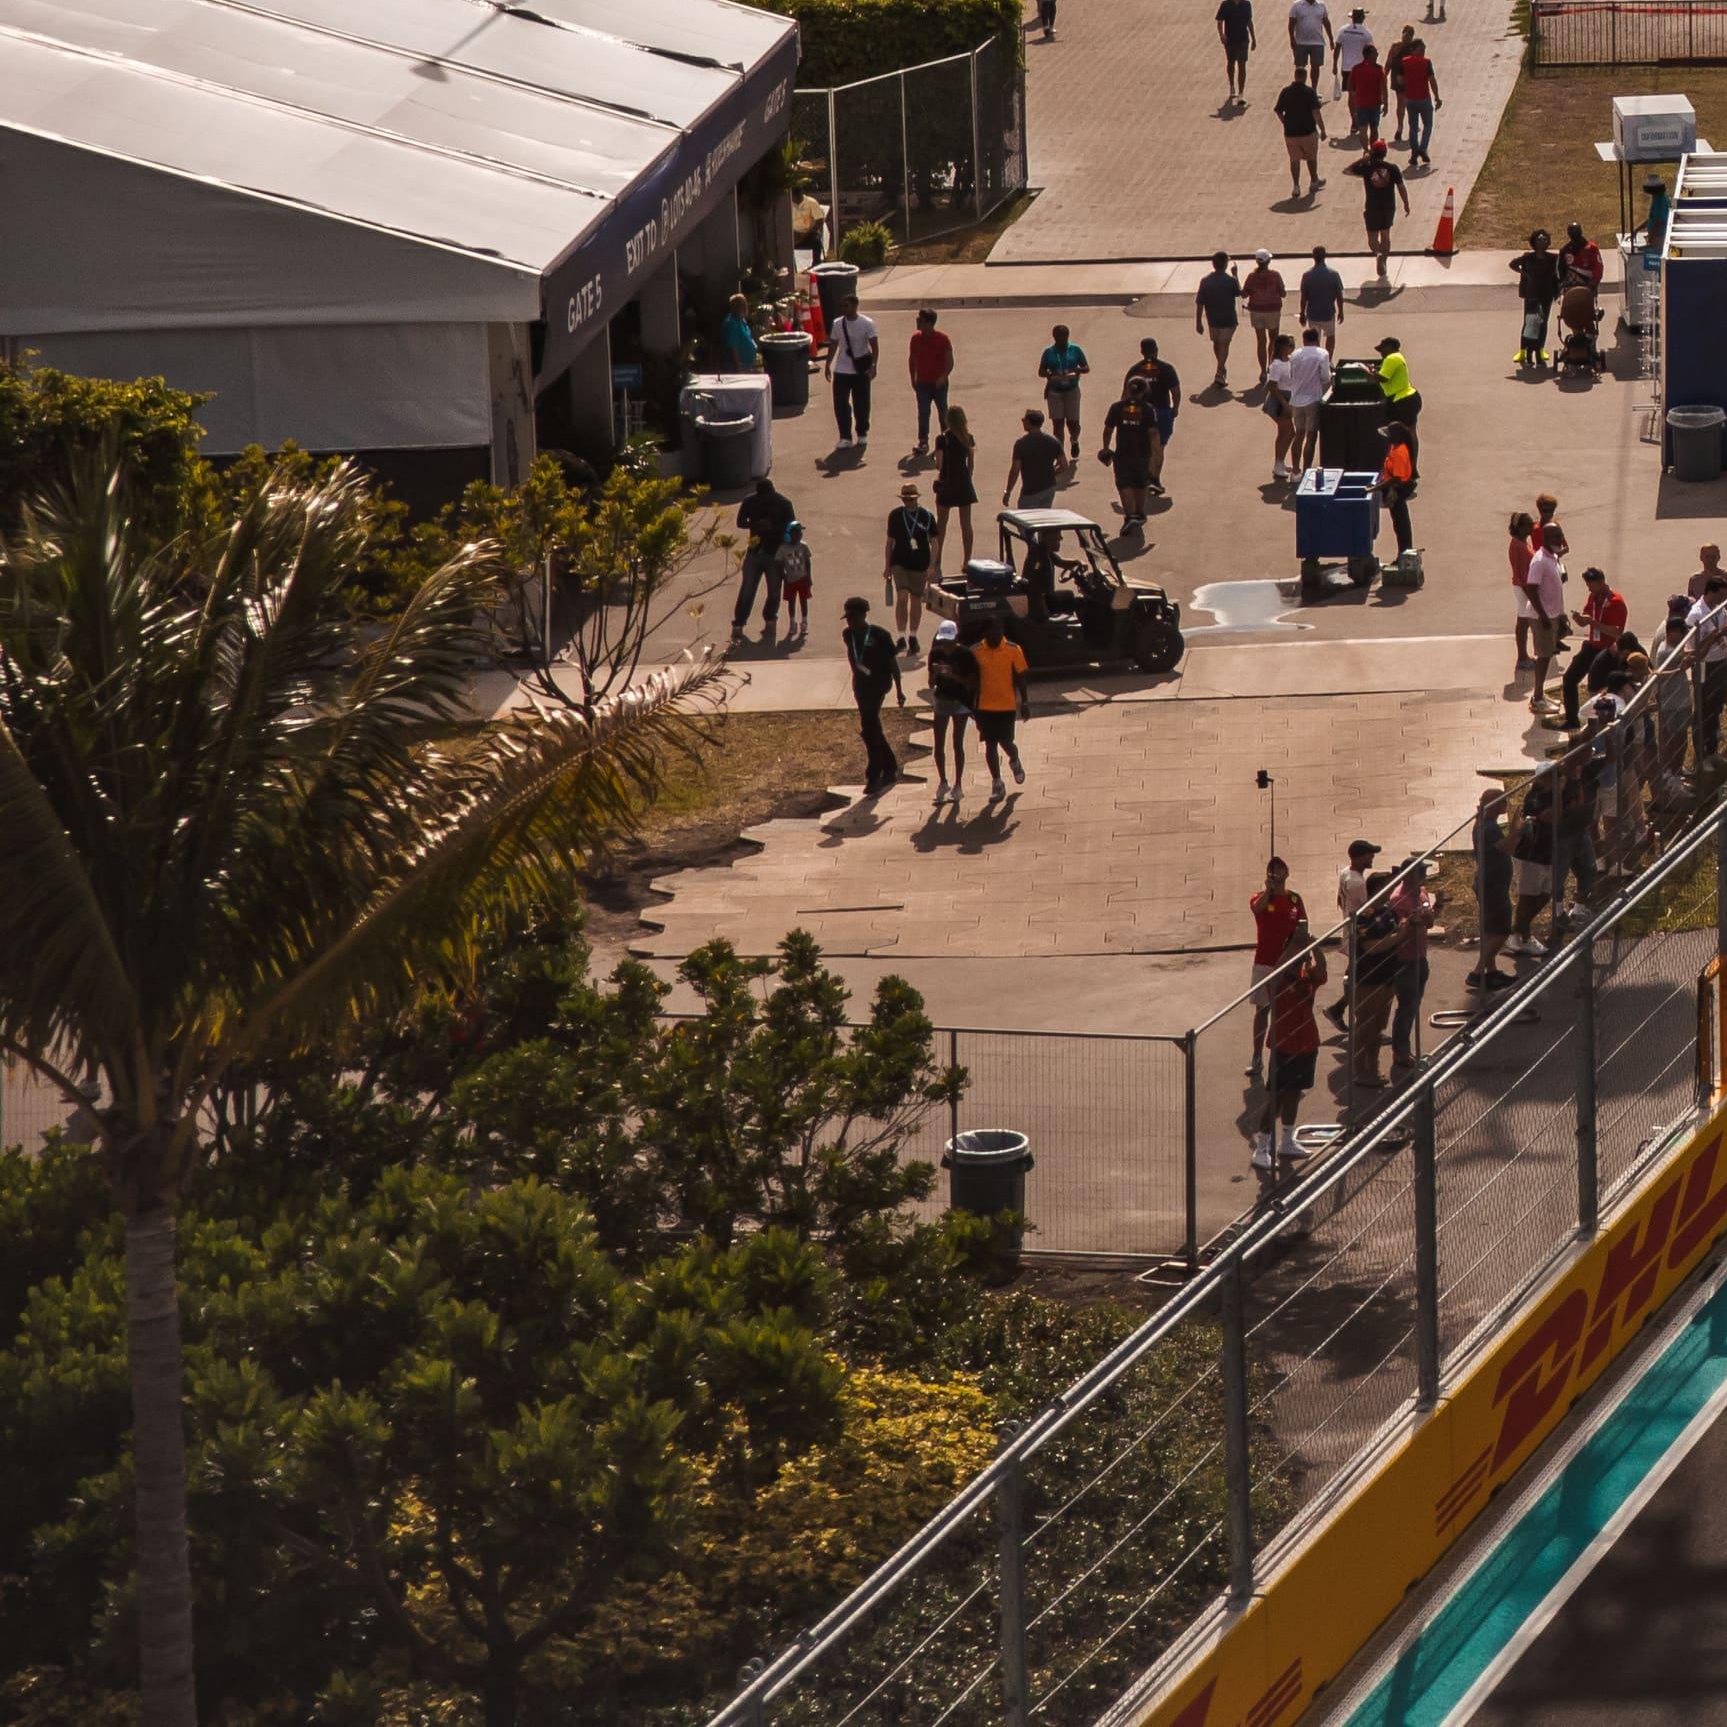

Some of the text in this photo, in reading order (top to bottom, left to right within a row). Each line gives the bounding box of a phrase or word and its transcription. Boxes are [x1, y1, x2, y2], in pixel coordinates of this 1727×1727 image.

[625, 235, 644, 275] EXIT
[567, 274, 602, 334] GATE 5
